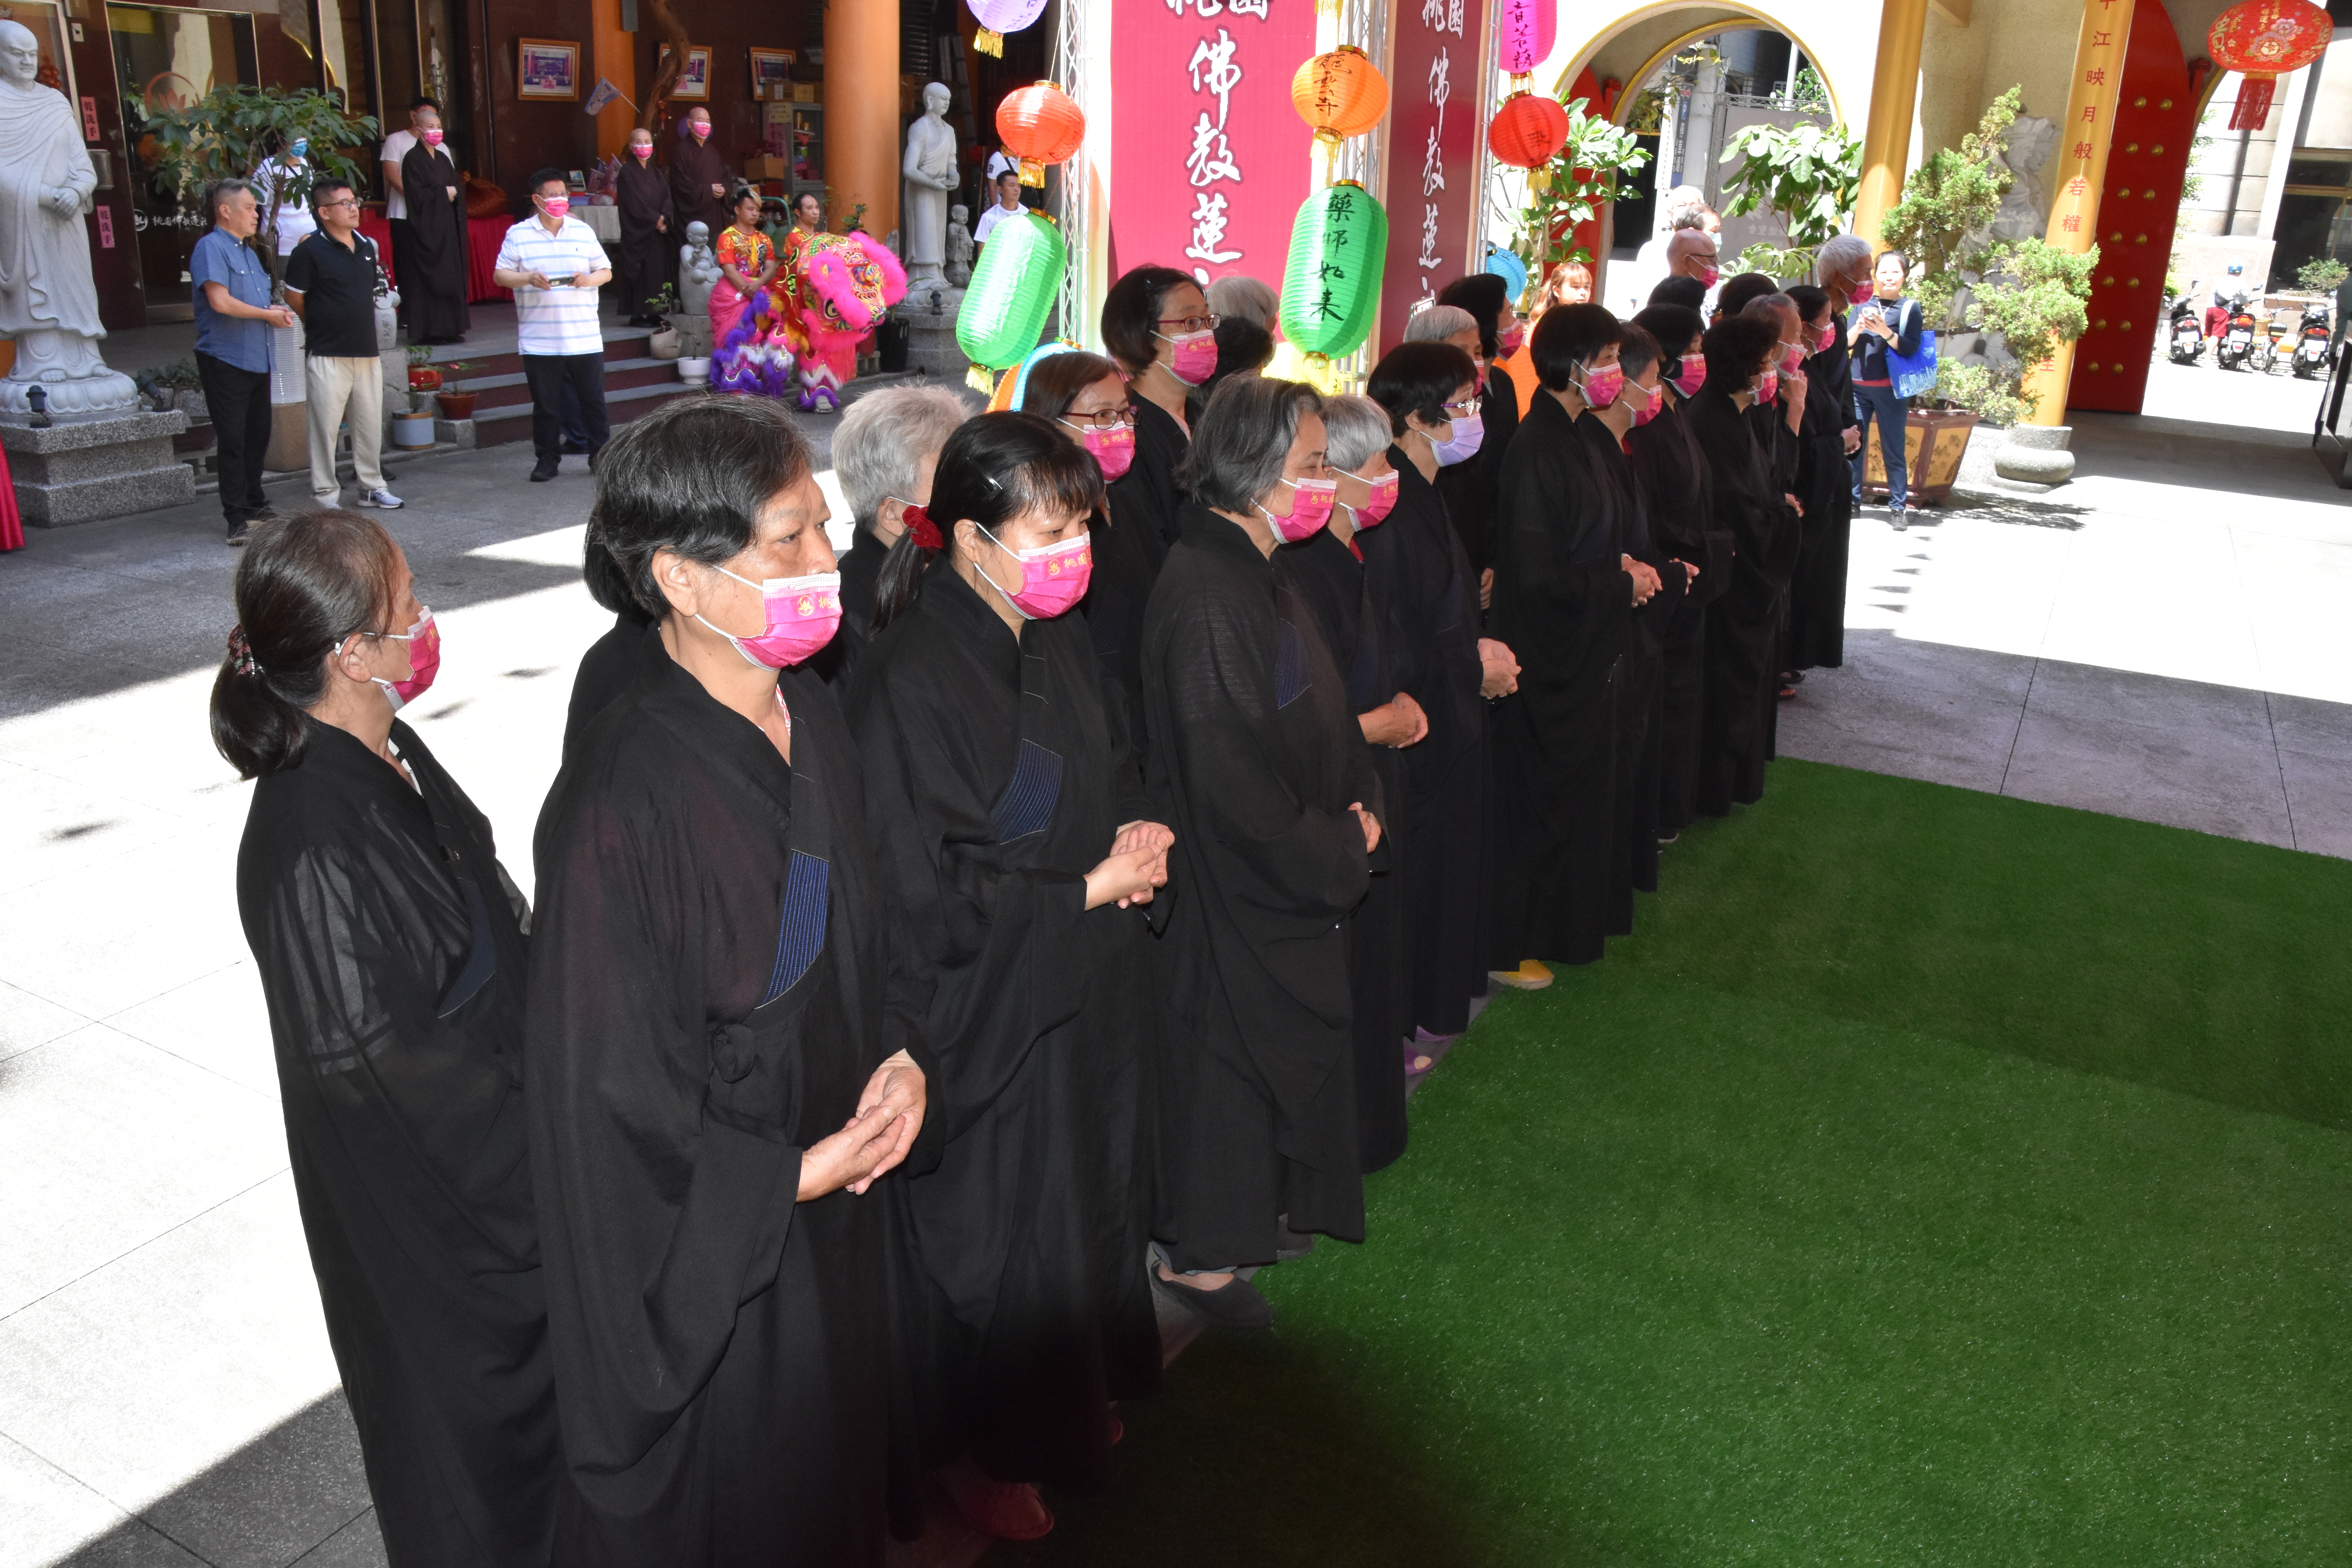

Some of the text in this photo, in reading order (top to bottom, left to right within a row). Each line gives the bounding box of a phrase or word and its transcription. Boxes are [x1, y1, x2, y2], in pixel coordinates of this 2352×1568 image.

[83, 101, 97, 137] 乾洗手
[1186, 29, 1242, 284] 佛教蓮
[1419, 46, 1450, 298] 佛教蓮
[2060, 0, 2116, 256] 江映月般若權
[100, 210, 112, 245] 乾洗手
[1310, 192, 1355, 321] 藥師如來
